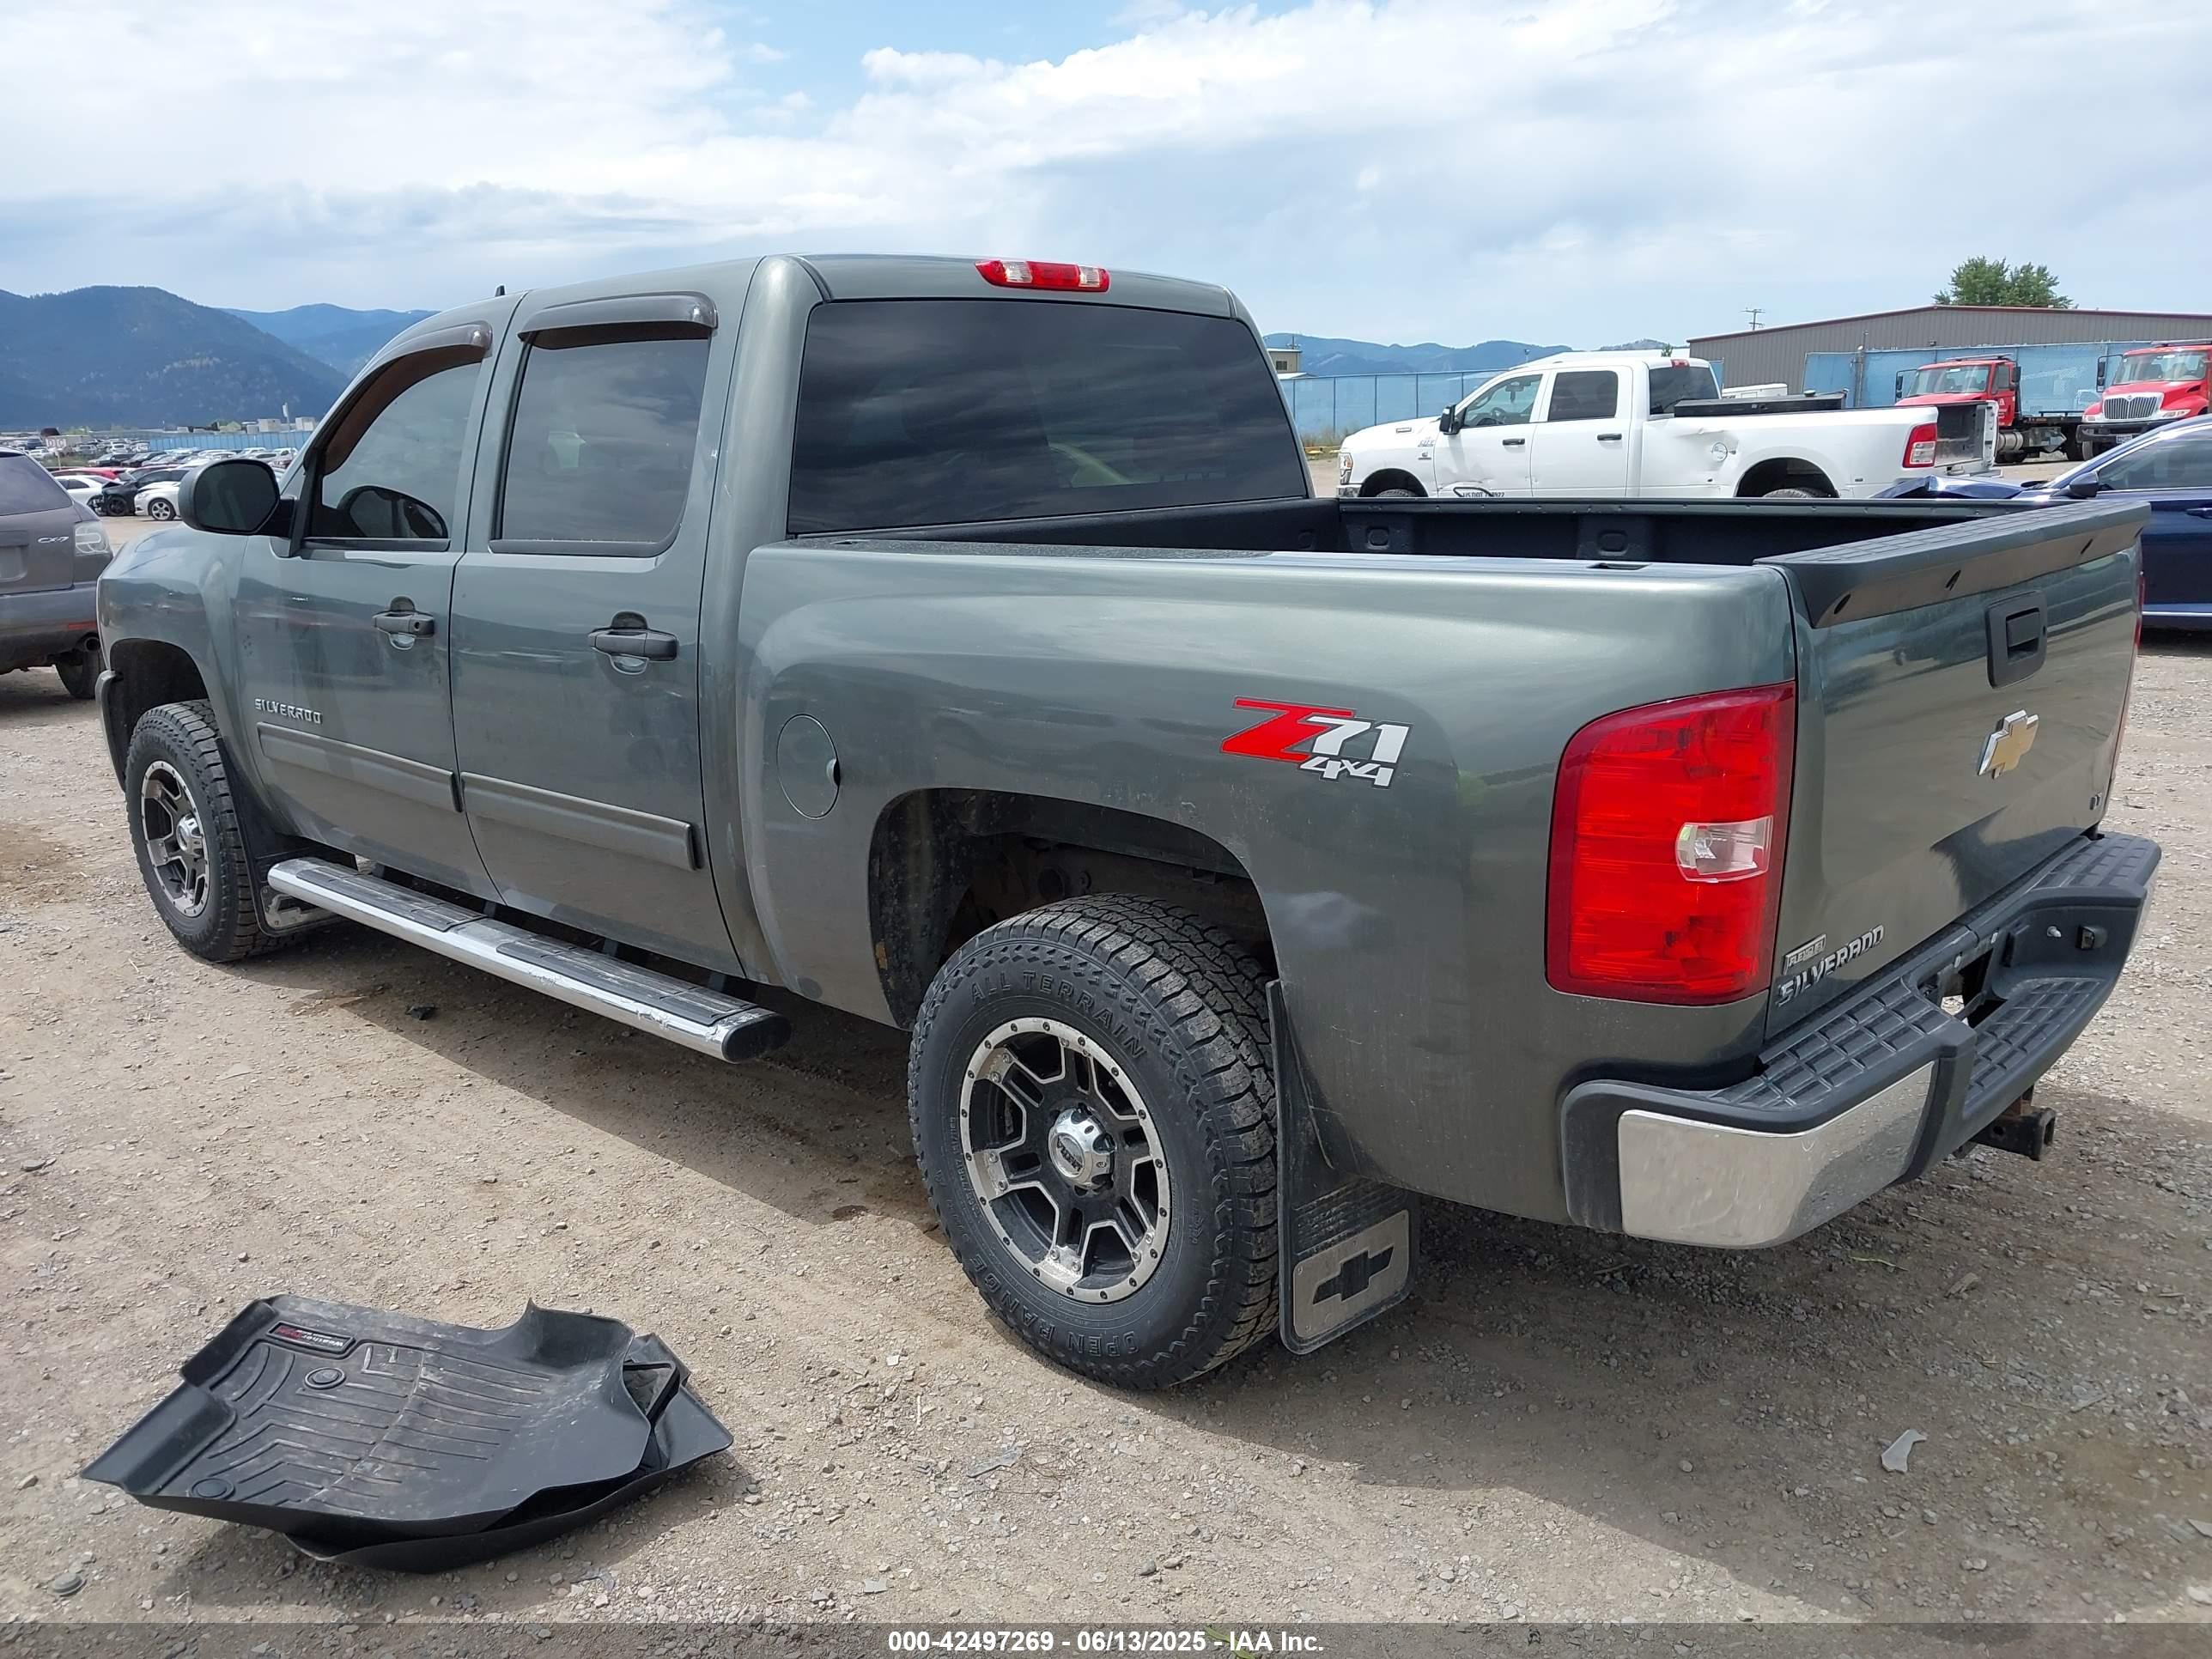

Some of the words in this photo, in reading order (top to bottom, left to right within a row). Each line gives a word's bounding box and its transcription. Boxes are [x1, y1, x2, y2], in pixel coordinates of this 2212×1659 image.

[254, 697, 323, 725] SILVERADO
[1219, 695, 1413, 765] Z71
[1776, 924, 1884, 1007] SILVERADO
[970, 972, 1012, 1004] ALL
[1023, 969, 1146, 1060] TERRAIN
[970, 1254, 1056, 1342] RANGE
[276, 1326, 343, 1347] WeatherT
[1067, 1330, 1139, 1357] OPEN
